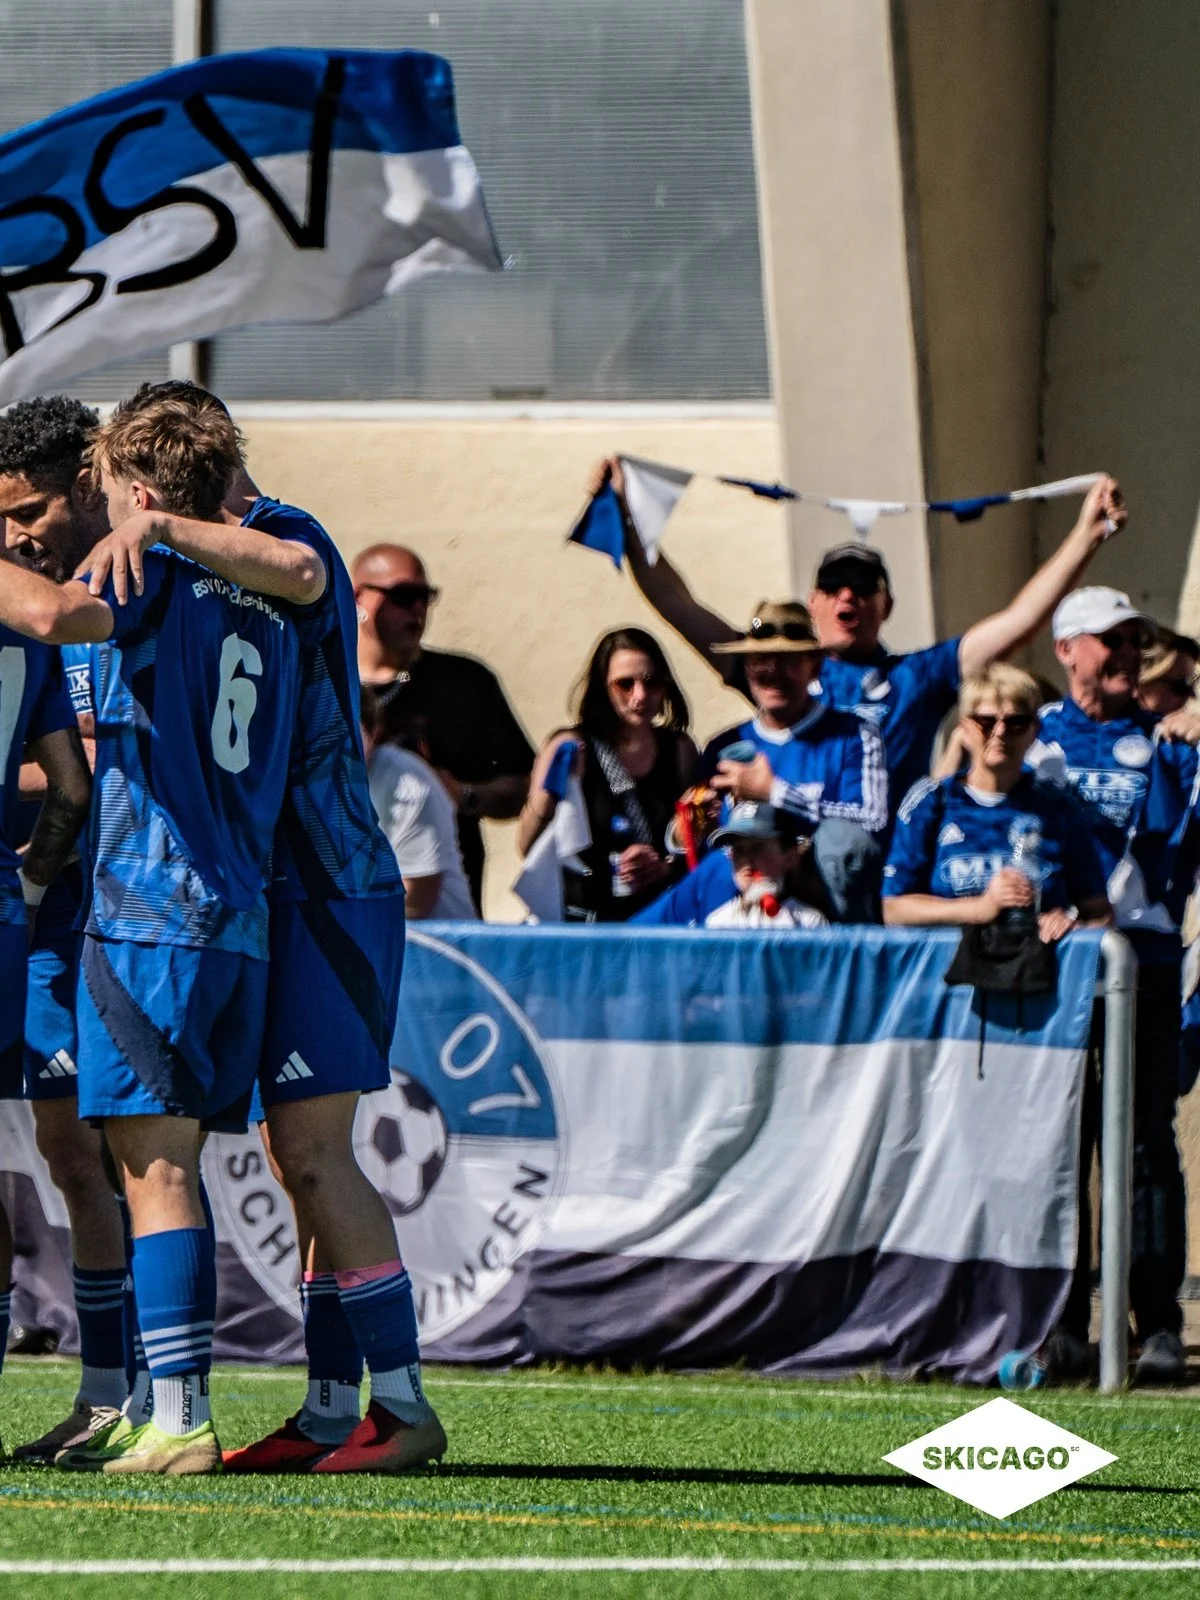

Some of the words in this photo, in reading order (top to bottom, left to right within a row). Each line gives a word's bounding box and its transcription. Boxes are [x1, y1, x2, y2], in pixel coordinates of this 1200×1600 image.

[192, 578, 215, 599] BSV
[66, 669, 90, 693] IX
[211, 632, 263, 774] 6
[440, 1013, 541, 1116] 07
